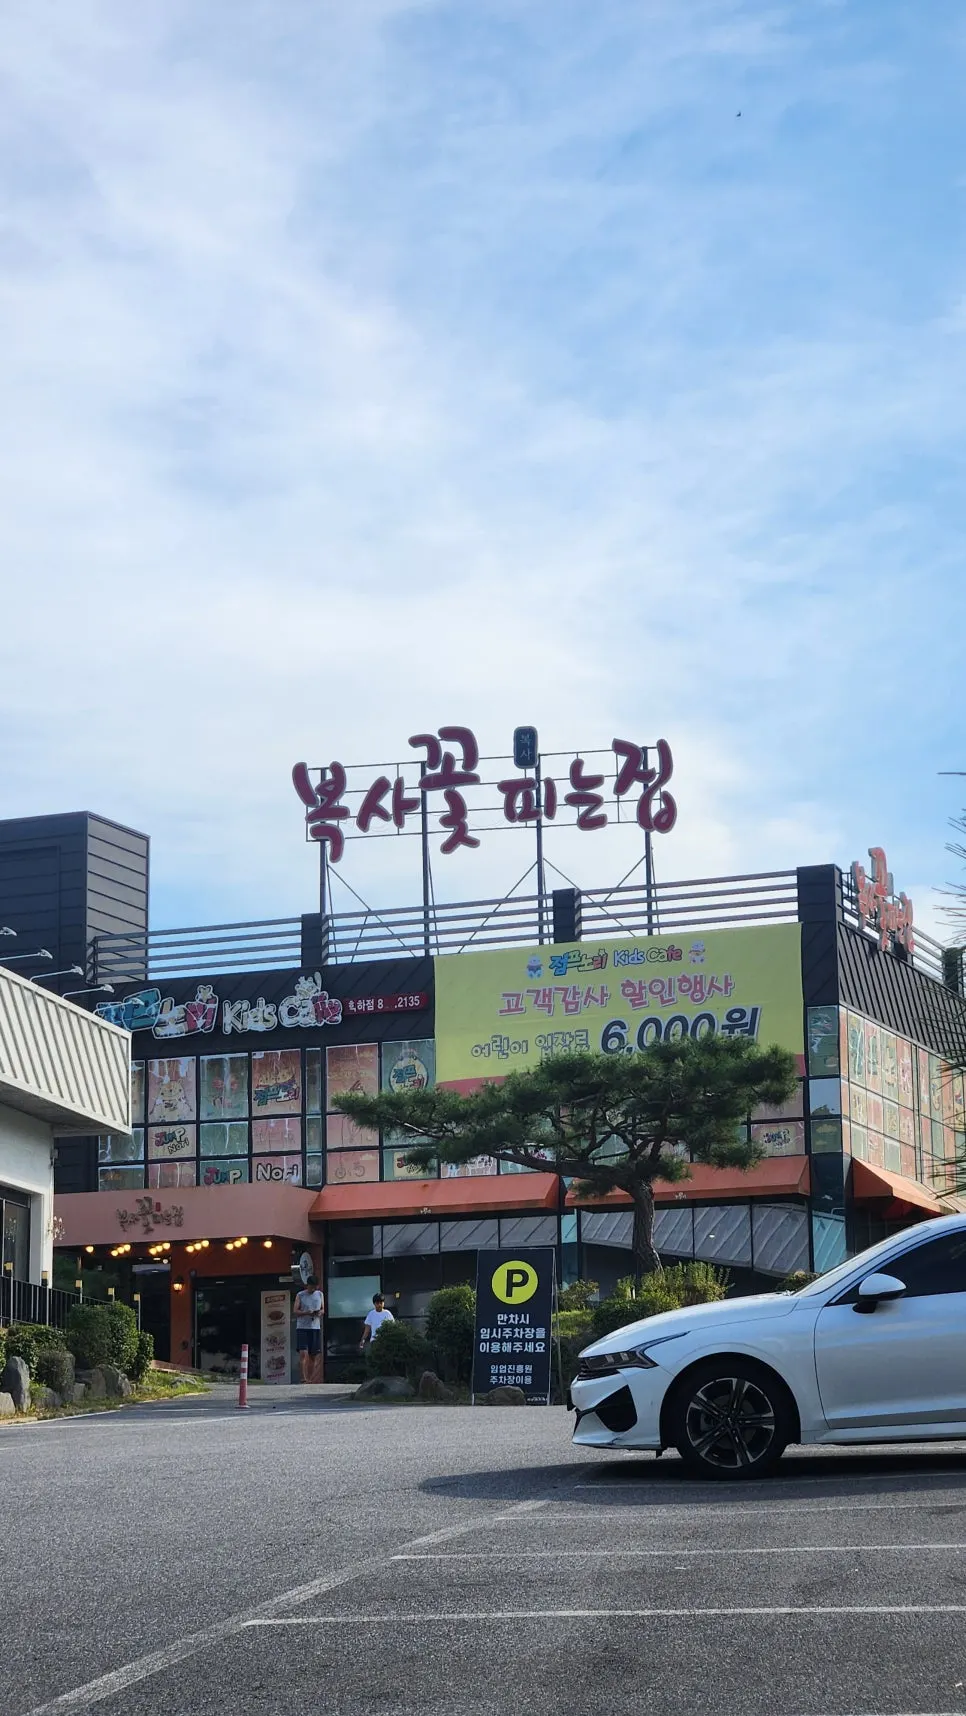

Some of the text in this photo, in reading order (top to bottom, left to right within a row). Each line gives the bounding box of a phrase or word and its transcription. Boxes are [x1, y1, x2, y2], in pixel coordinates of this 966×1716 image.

[549, 945, 683, 977] 점프노리 Kids Cafe
[499, 974, 735, 1016] 고객감사 할인행사
[222, 996, 279, 1035] Kids
[471, 1034, 529, 1060] 어린이
[506, 1268, 530, 1298] P
[497, 1313, 530, 1326] 만차시
[480, 1327, 546, 1340] 임시주차장을
[479, 1341, 546, 1353] 이용해주세요
[490, 1364, 533, 1374] 임업진흥원
[489, 1375, 532, 1385] 주차장이용
